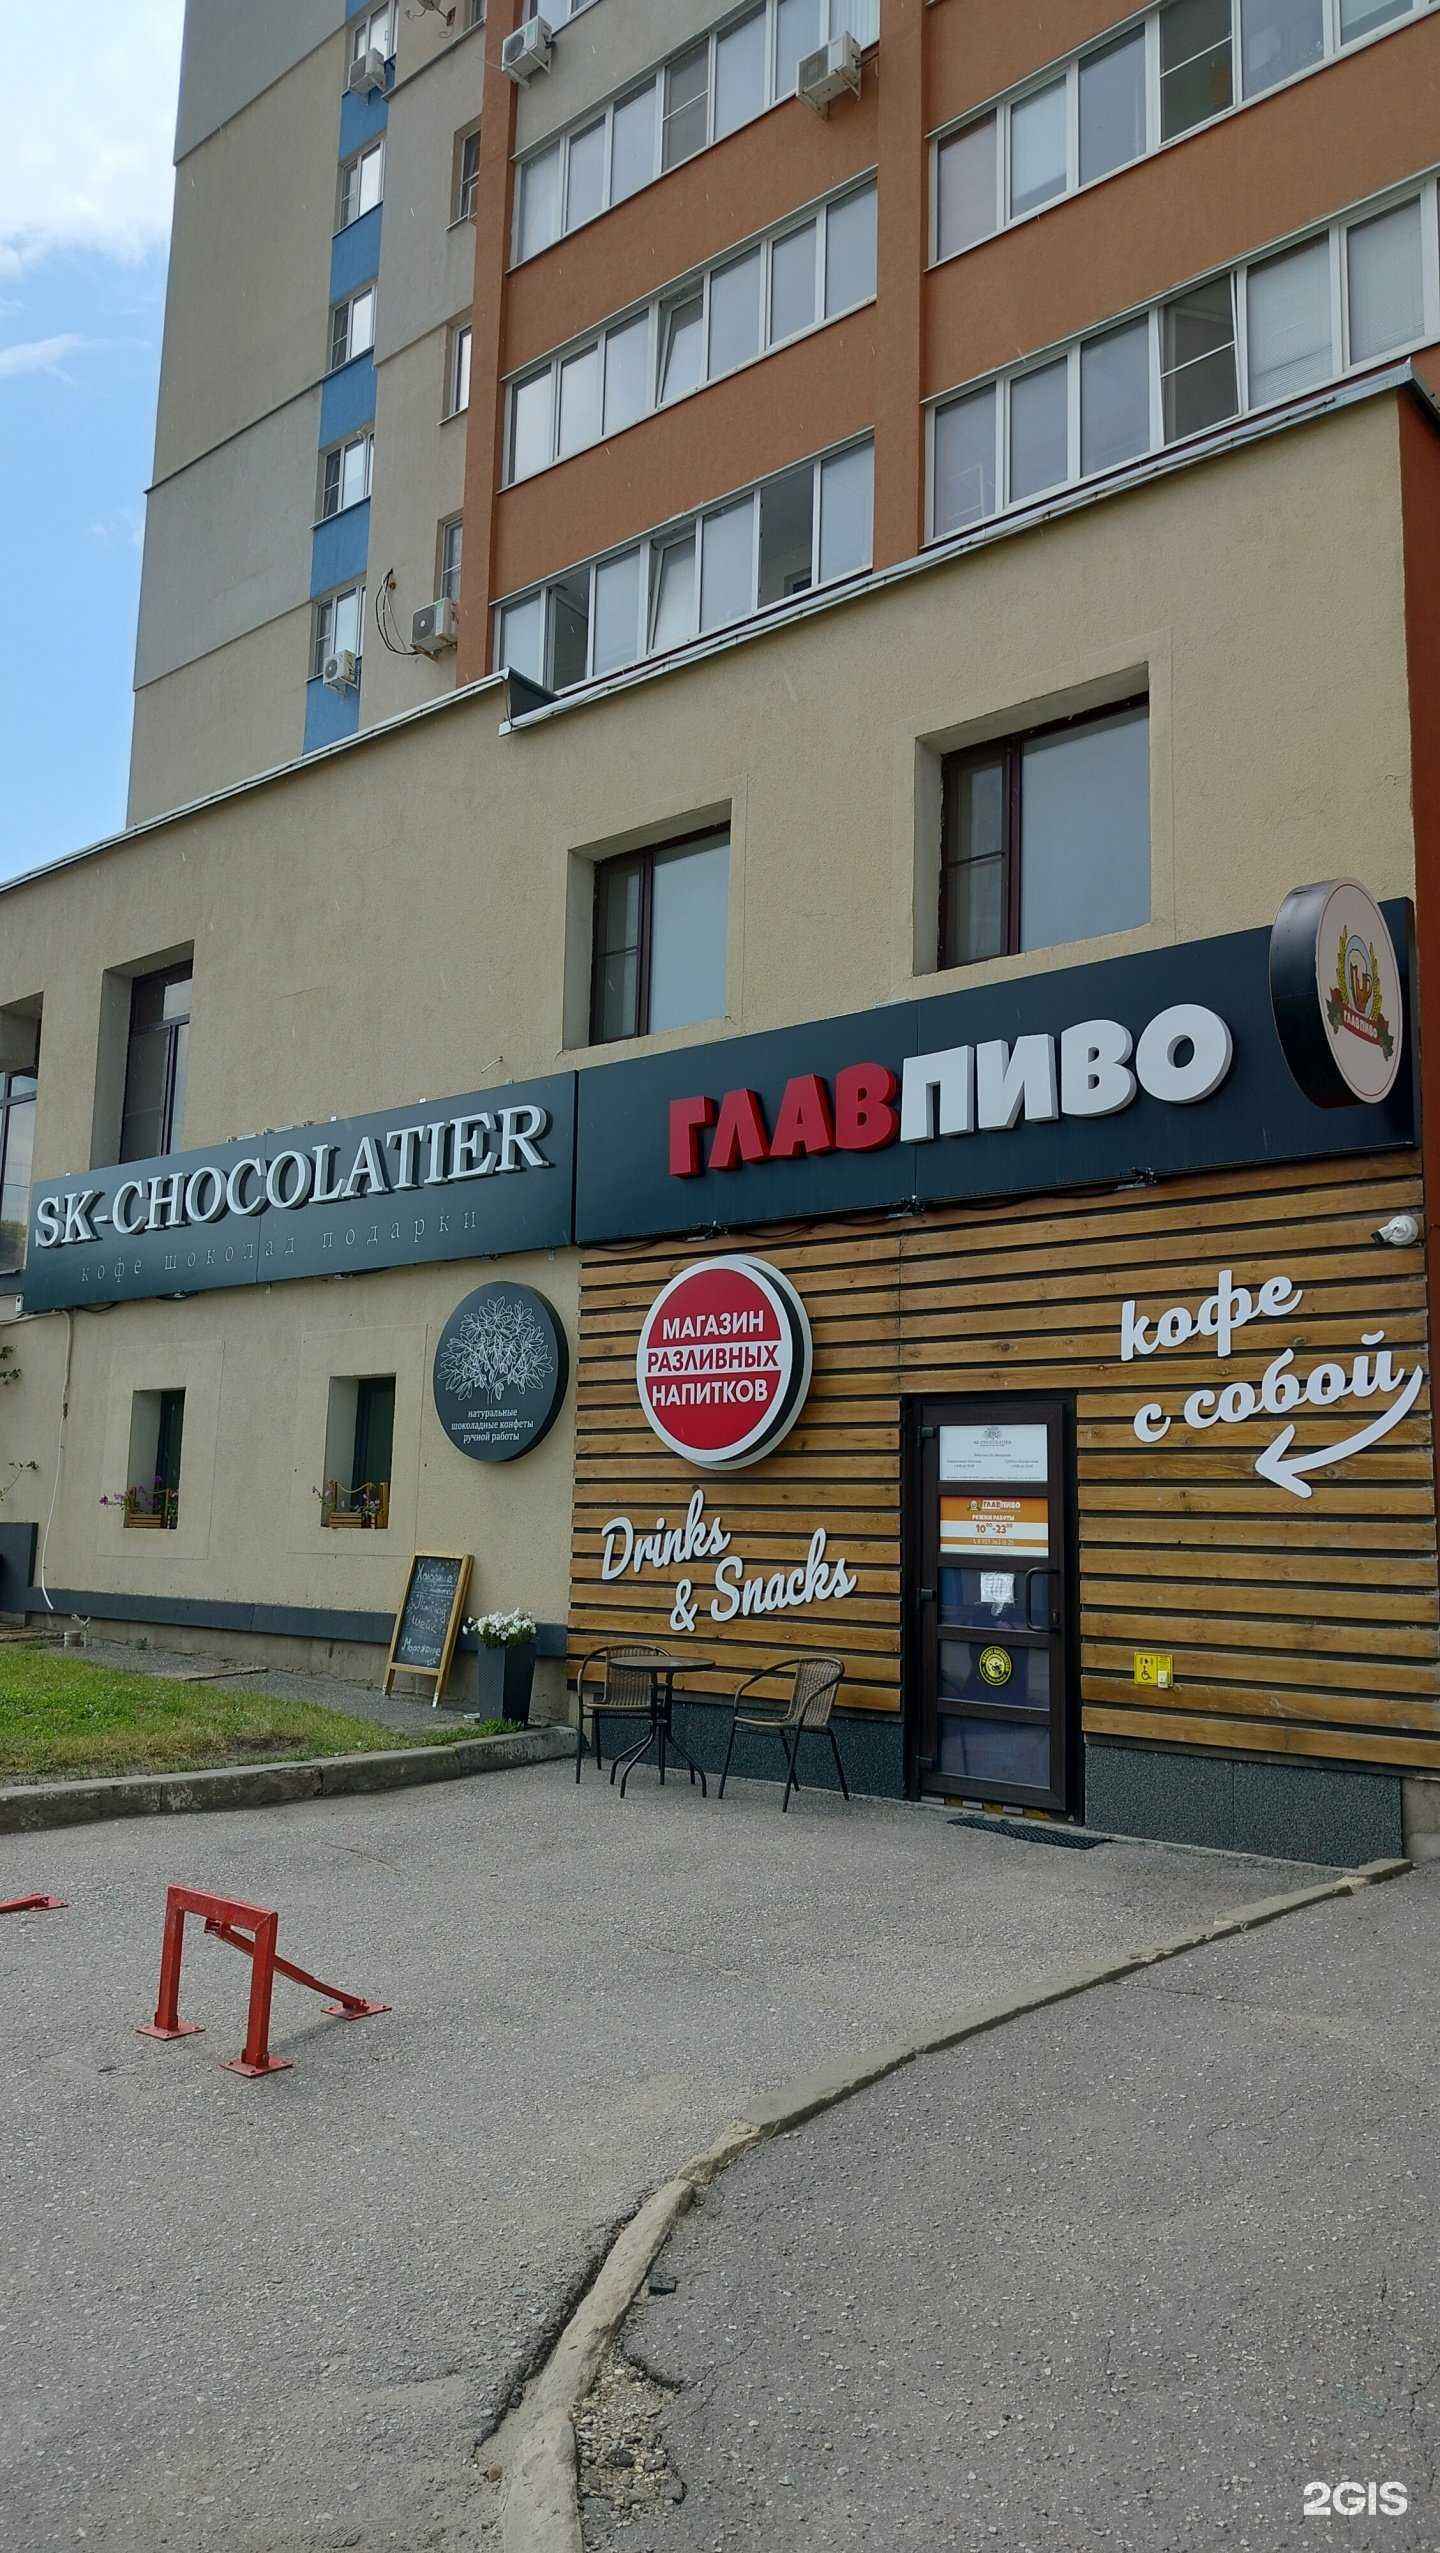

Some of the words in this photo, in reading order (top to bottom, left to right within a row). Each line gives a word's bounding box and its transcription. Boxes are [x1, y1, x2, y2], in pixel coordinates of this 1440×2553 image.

[669, 1003, 1233, 1177] ГЛАВПИВО
[35, 1104, 551, 1248] SK-CHOCOLATIER
[80, 1254, 143, 1283] кофе
[164, 1235, 296, 1271] шоколад
[322, 1208, 479, 1249] подарки
[662, 1310, 764, 1340] МАГАЗИН
[1121, 1269, 1303, 1361] кофе
[647, 1344, 780, 1373] РАЗЛИВНЫХ
[652, 1379, 768, 1407] НАПИТКОВ
[1183, 1330, 1405, 1429] собой
[451, 1421, 499, 1431] шоколадные
[499, 1419, 534, 1431] конфеты
[463, 1432, 490, 1444] ручной
[491, 1431, 520, 1443] работы
[467, 1408, 518, 1420] натуральные
[602, 1489, 731, 1580] Drinks
[669, 1579, 699, 1632] &
[711, 1528, 858, 1622] Snacks
